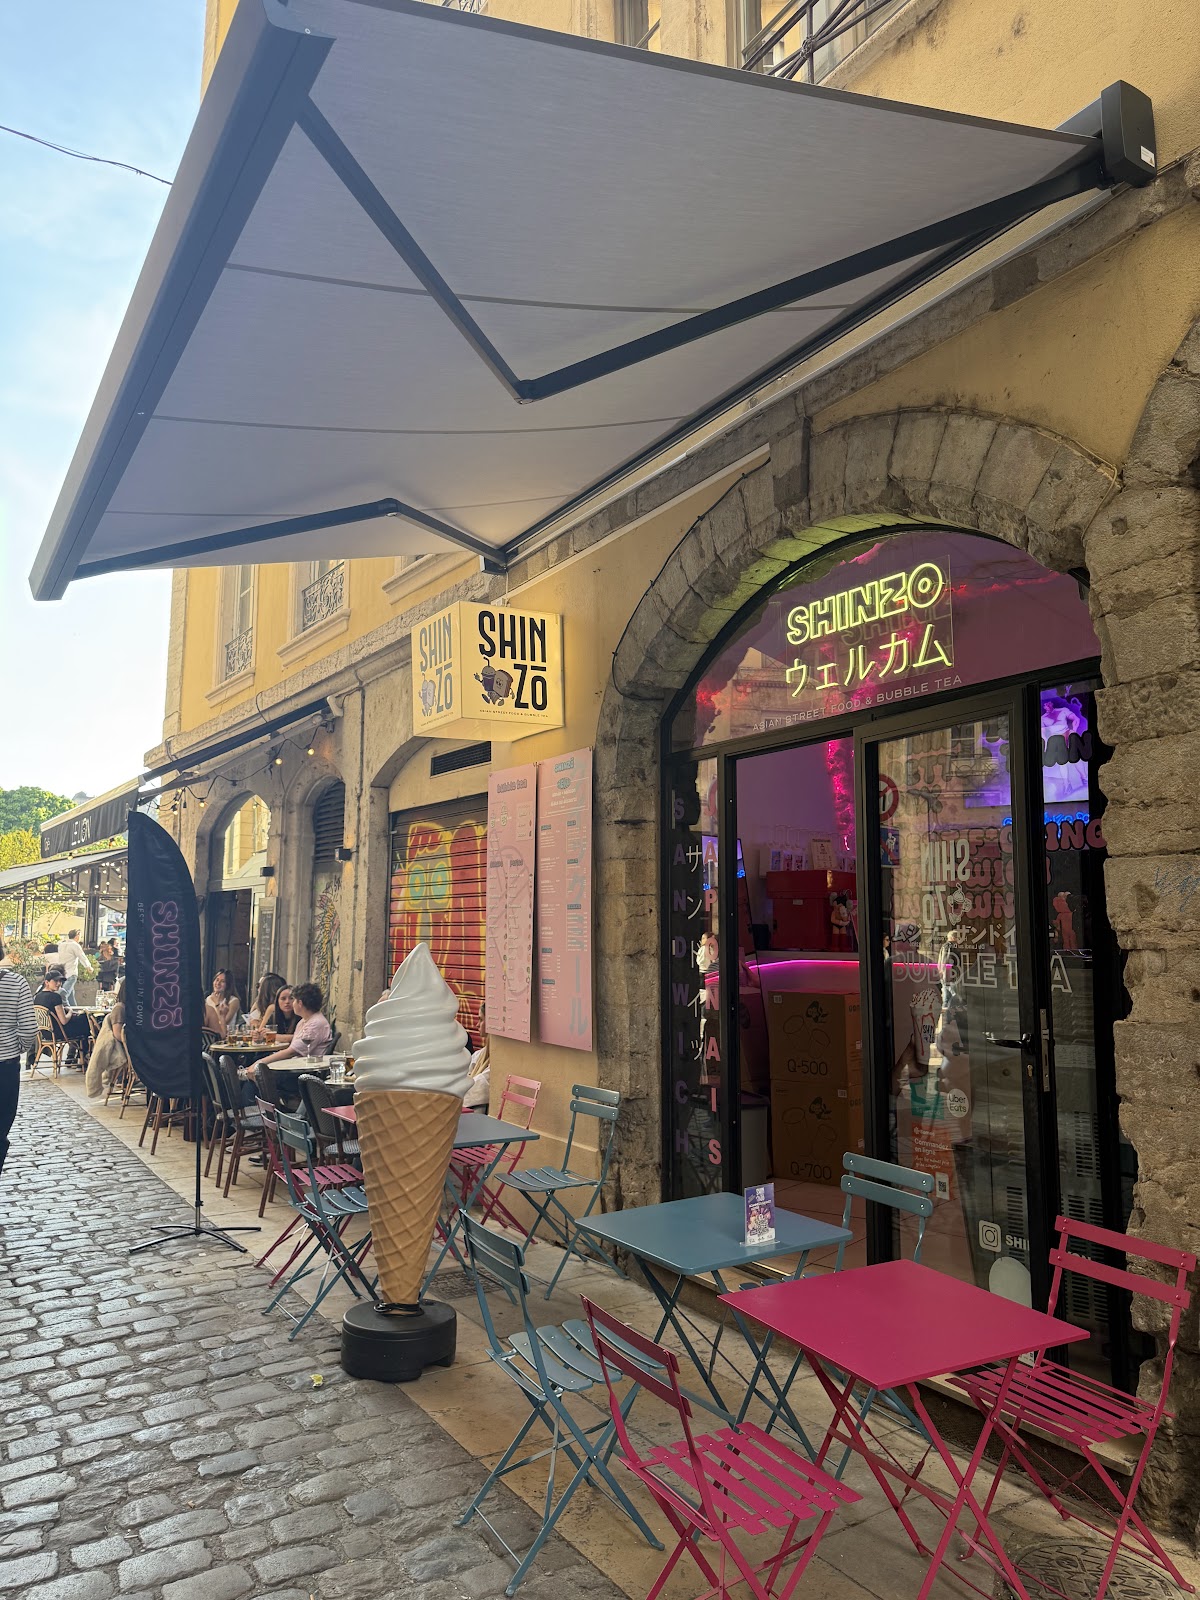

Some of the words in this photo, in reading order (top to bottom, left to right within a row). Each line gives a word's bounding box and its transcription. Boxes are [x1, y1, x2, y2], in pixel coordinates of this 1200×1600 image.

[419, 612, 452, 673] SHIN
[478, 610, 547, 663] SHIN
[785, 623, 953, 698] ウェルカム
[752, 716, 783, 732] ASIAN
[785, 706, 828, 726] STREET
[830, 699, 861, 714] FOOD
[865, 697, 872, 705] &
[876, 682, 929, 704] BUBBLE
[934, 674, 962, 690] TEA
[136, 987, 145, 997] IN
[135, 1000, 145, 1026] TOWN
[787, 1058, 828, 1076] Q-500
[949, 1093, 967, 1104] Uber
[949, 1103, 967, 1114] Eats
[791, 1160, 832, 1181] Q-700
